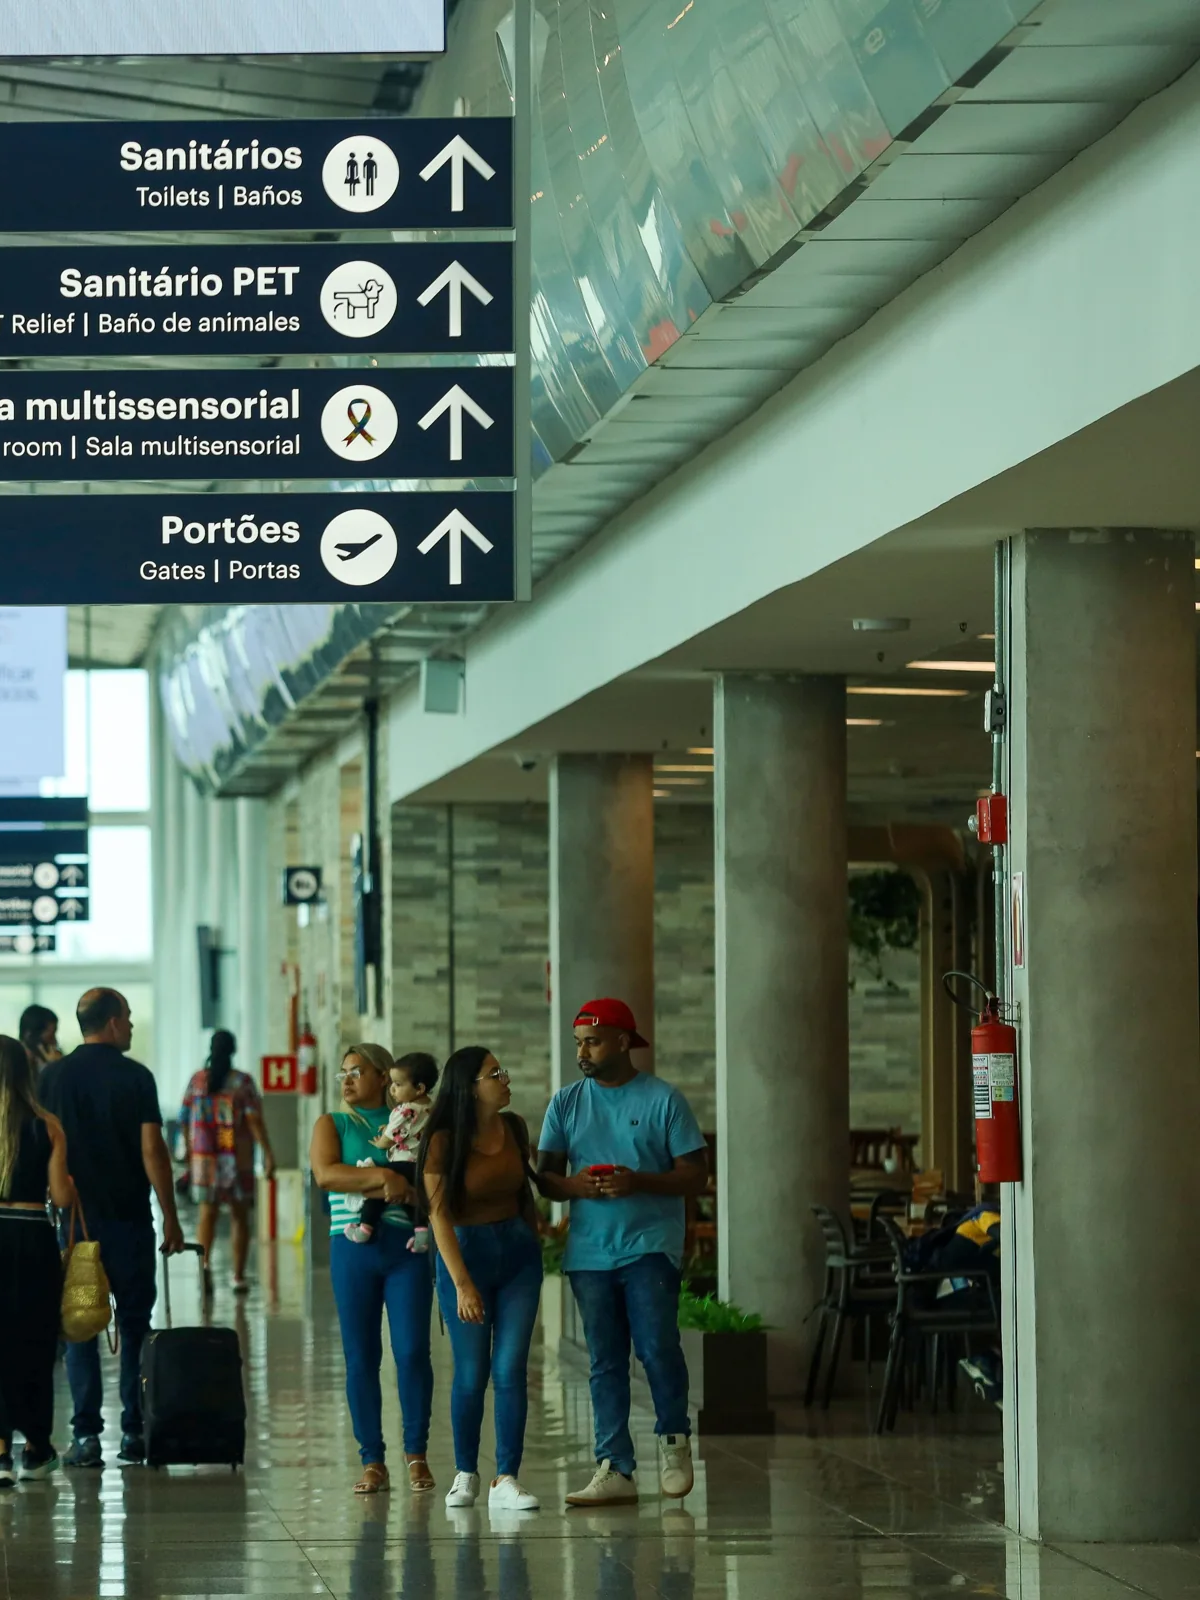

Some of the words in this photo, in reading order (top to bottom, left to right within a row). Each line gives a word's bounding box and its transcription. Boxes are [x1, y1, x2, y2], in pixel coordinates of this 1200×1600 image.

[119, 138, 303, 172] Sanitários
[135, 184, 210, 207] Toilets
[233, 185, 303, 206] Baños
[59, 265, 223, 298] Sanitário
[233, 266, 301, 296] PET
[12, 312, 76, 334] Relief
[98, 312, 156, 334] Baño
[162, 311, 192, 333] de
[198, 310, 301, 333] animales
[26, 388, 300, 421] multissensorial
[3, 441, 62, 457] room
[85, 434, 133, 457] Sala
[141, 433, 300, 456] multisensorial
[161, 513, 301, 545] Portões
[139, 560, 206, 581] Gates
[229, 560, 301, 580] Portas
[269, 1060, 291, 1087] H
